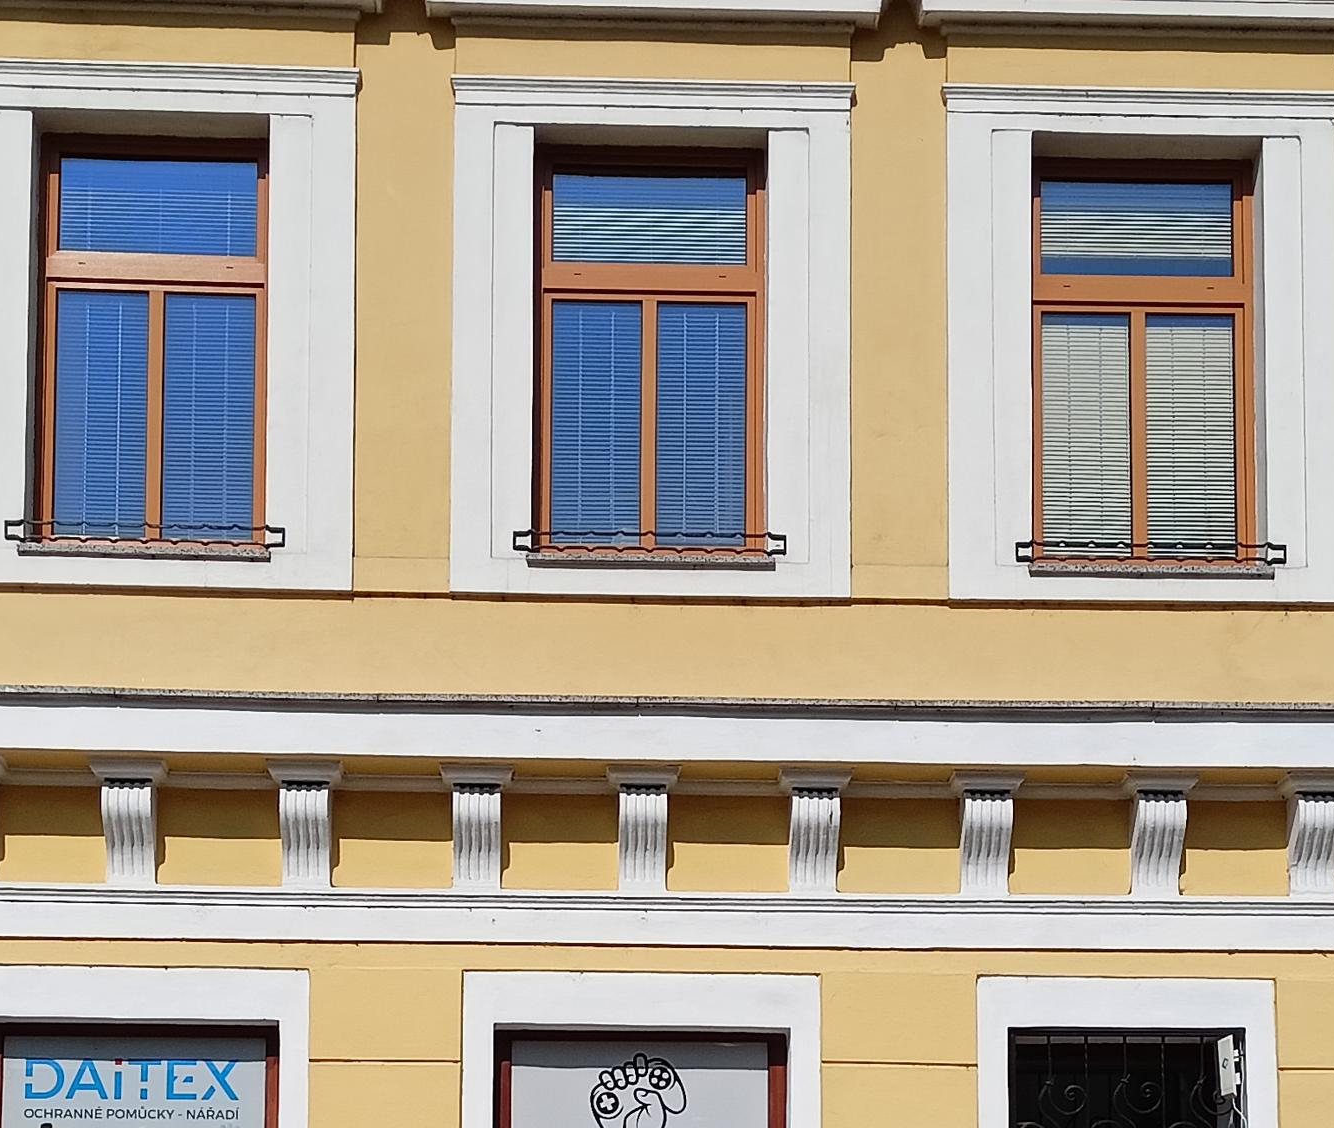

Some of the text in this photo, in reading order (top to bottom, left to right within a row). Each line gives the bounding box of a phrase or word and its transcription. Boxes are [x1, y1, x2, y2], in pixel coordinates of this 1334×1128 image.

[23, 1106, 103, 1120] OCHRANNÉ
[106, 1106, 175, 1120] POMŮCKY
[186, 1107, 240, 1120] NÁŘADÍ
